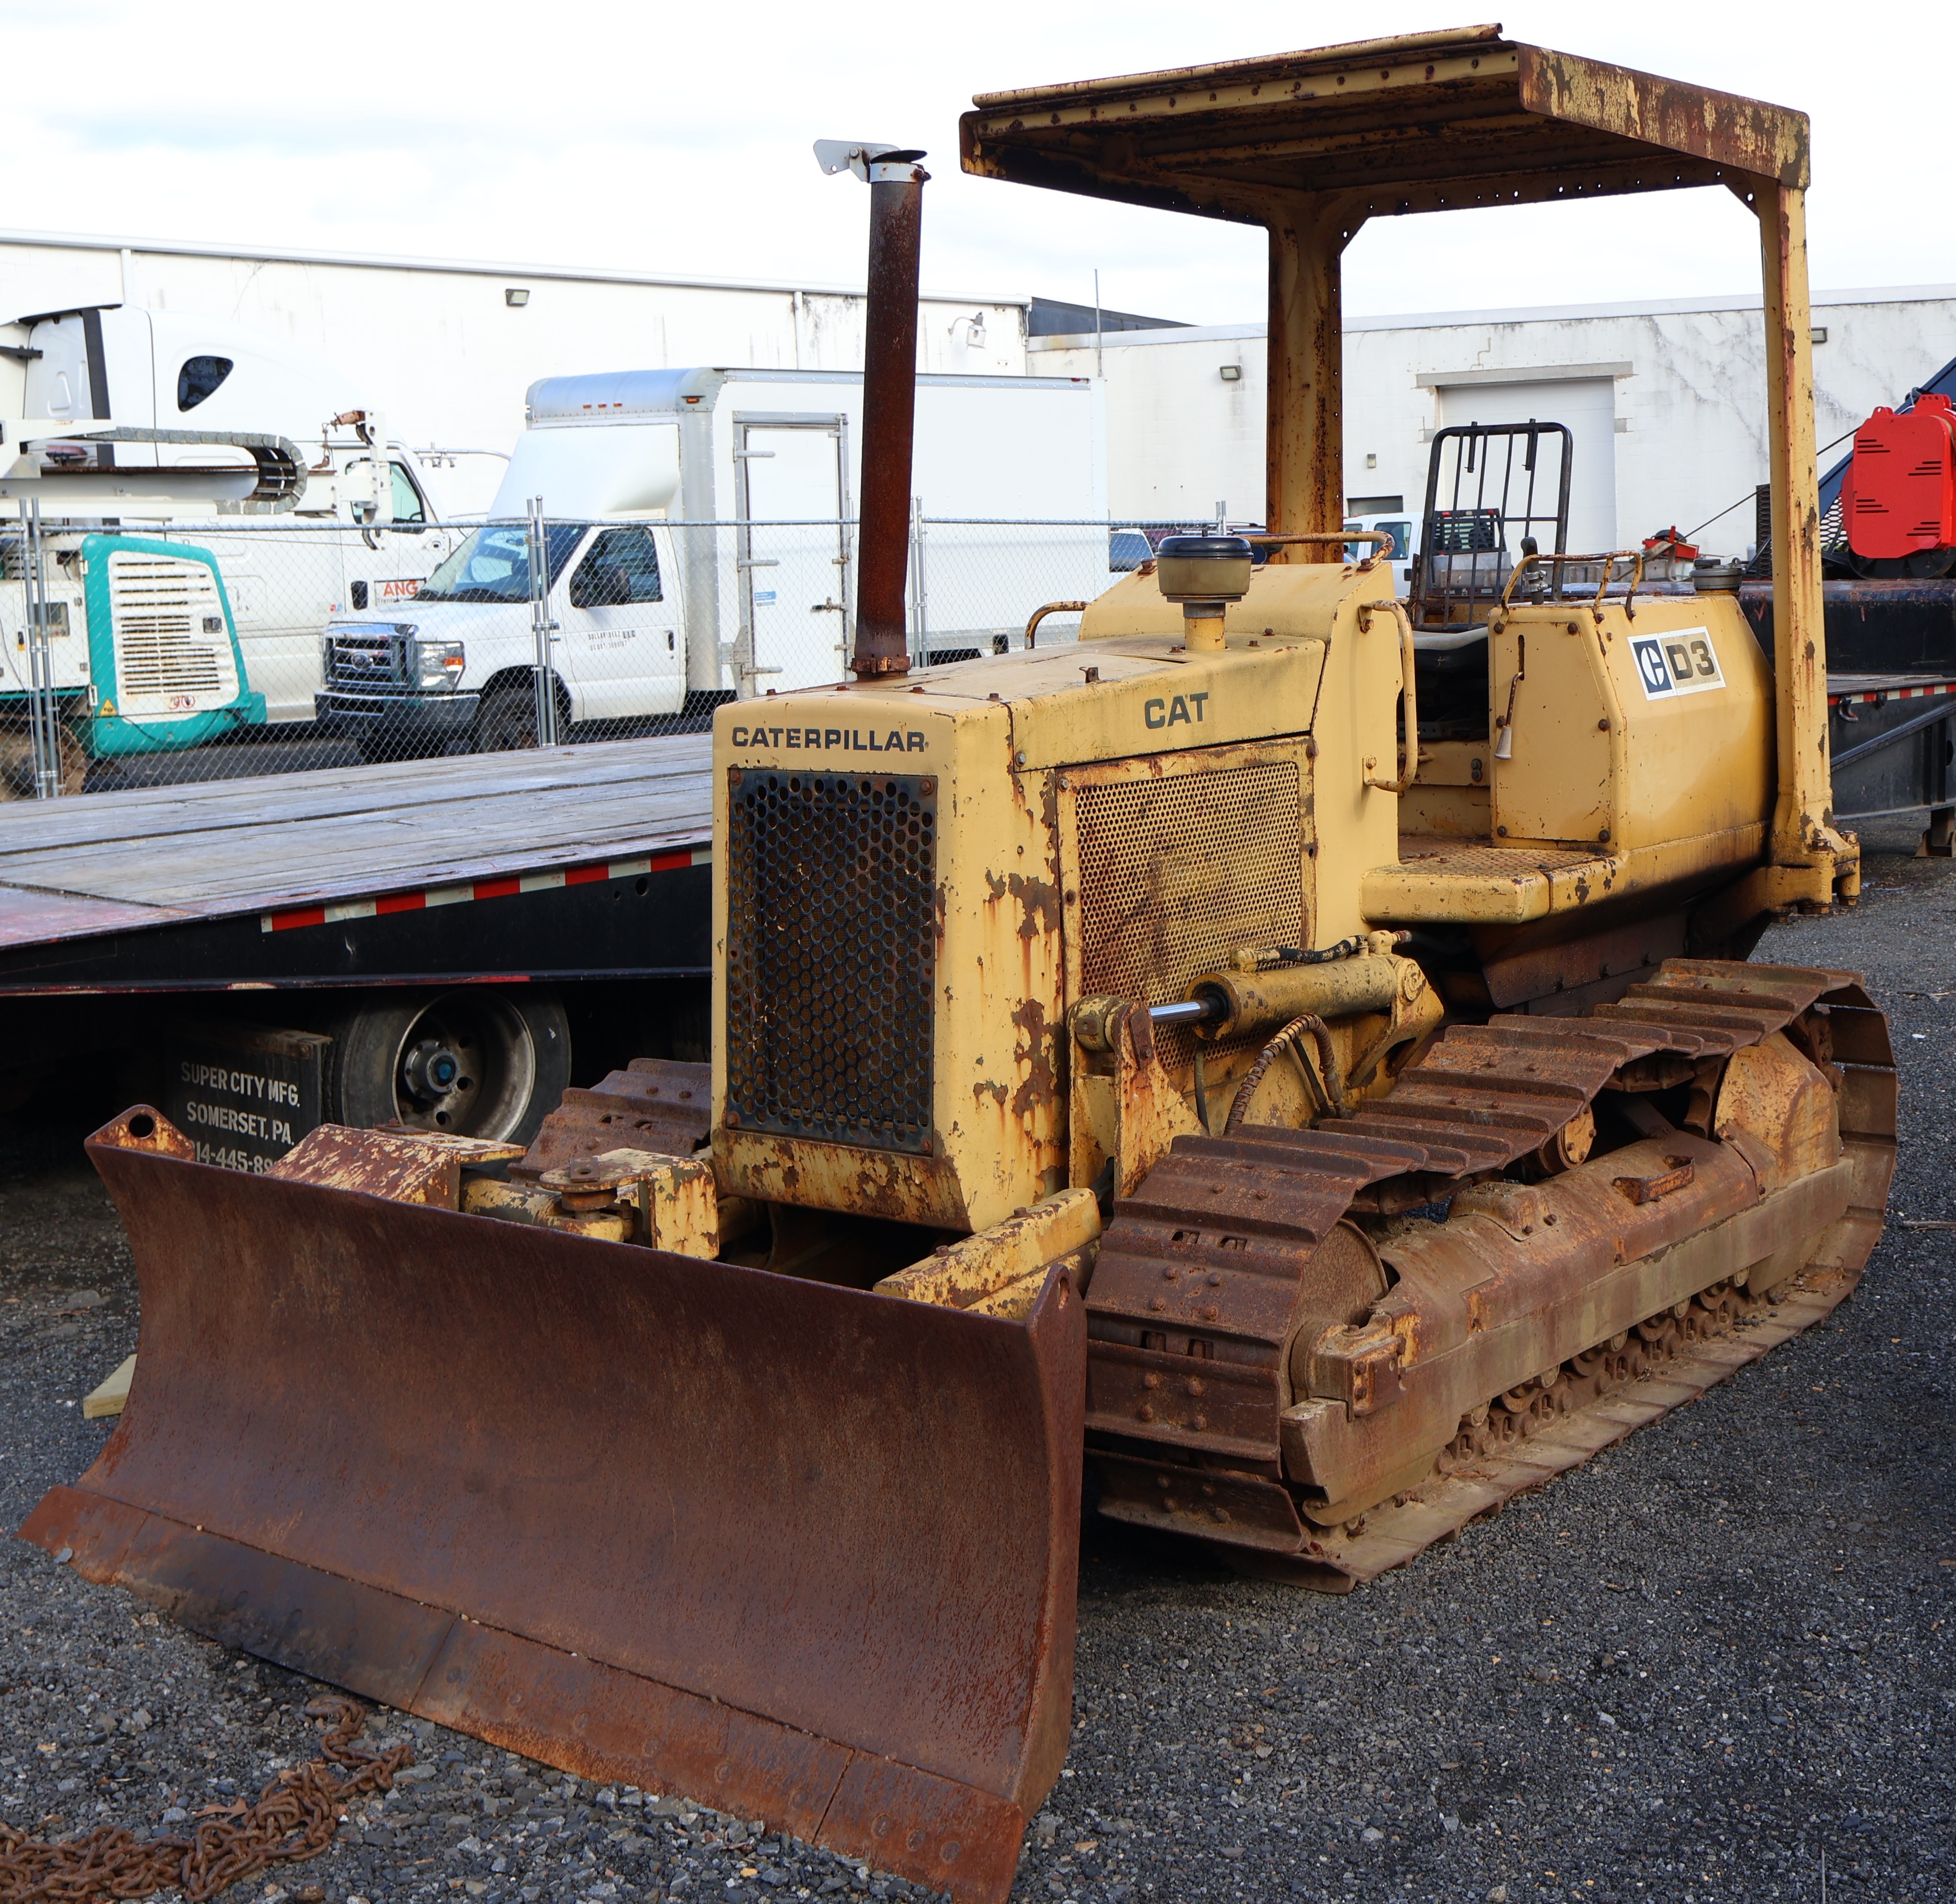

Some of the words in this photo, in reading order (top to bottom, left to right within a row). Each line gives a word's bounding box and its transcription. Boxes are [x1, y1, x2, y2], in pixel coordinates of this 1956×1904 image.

[384, 580, 418, 596] ANG
[623, 630, 635, 639] LLC
[1665, 640, 1715, 681] D3
[1144, 692, 1209, 729] CAT
[732, 726, 925, 752] CATERPILLAR
[181, 1061, 228, 1091] SUPER
[230, 1071, 265, 1098] CITY
[268, 1079, 300, 1108] MFG.
[187, 1101, 269, 1140] SOMERSET,
[272, 1119, 295, 1146] PA.
[190, 1139, 276, 1175] 14-445-89
